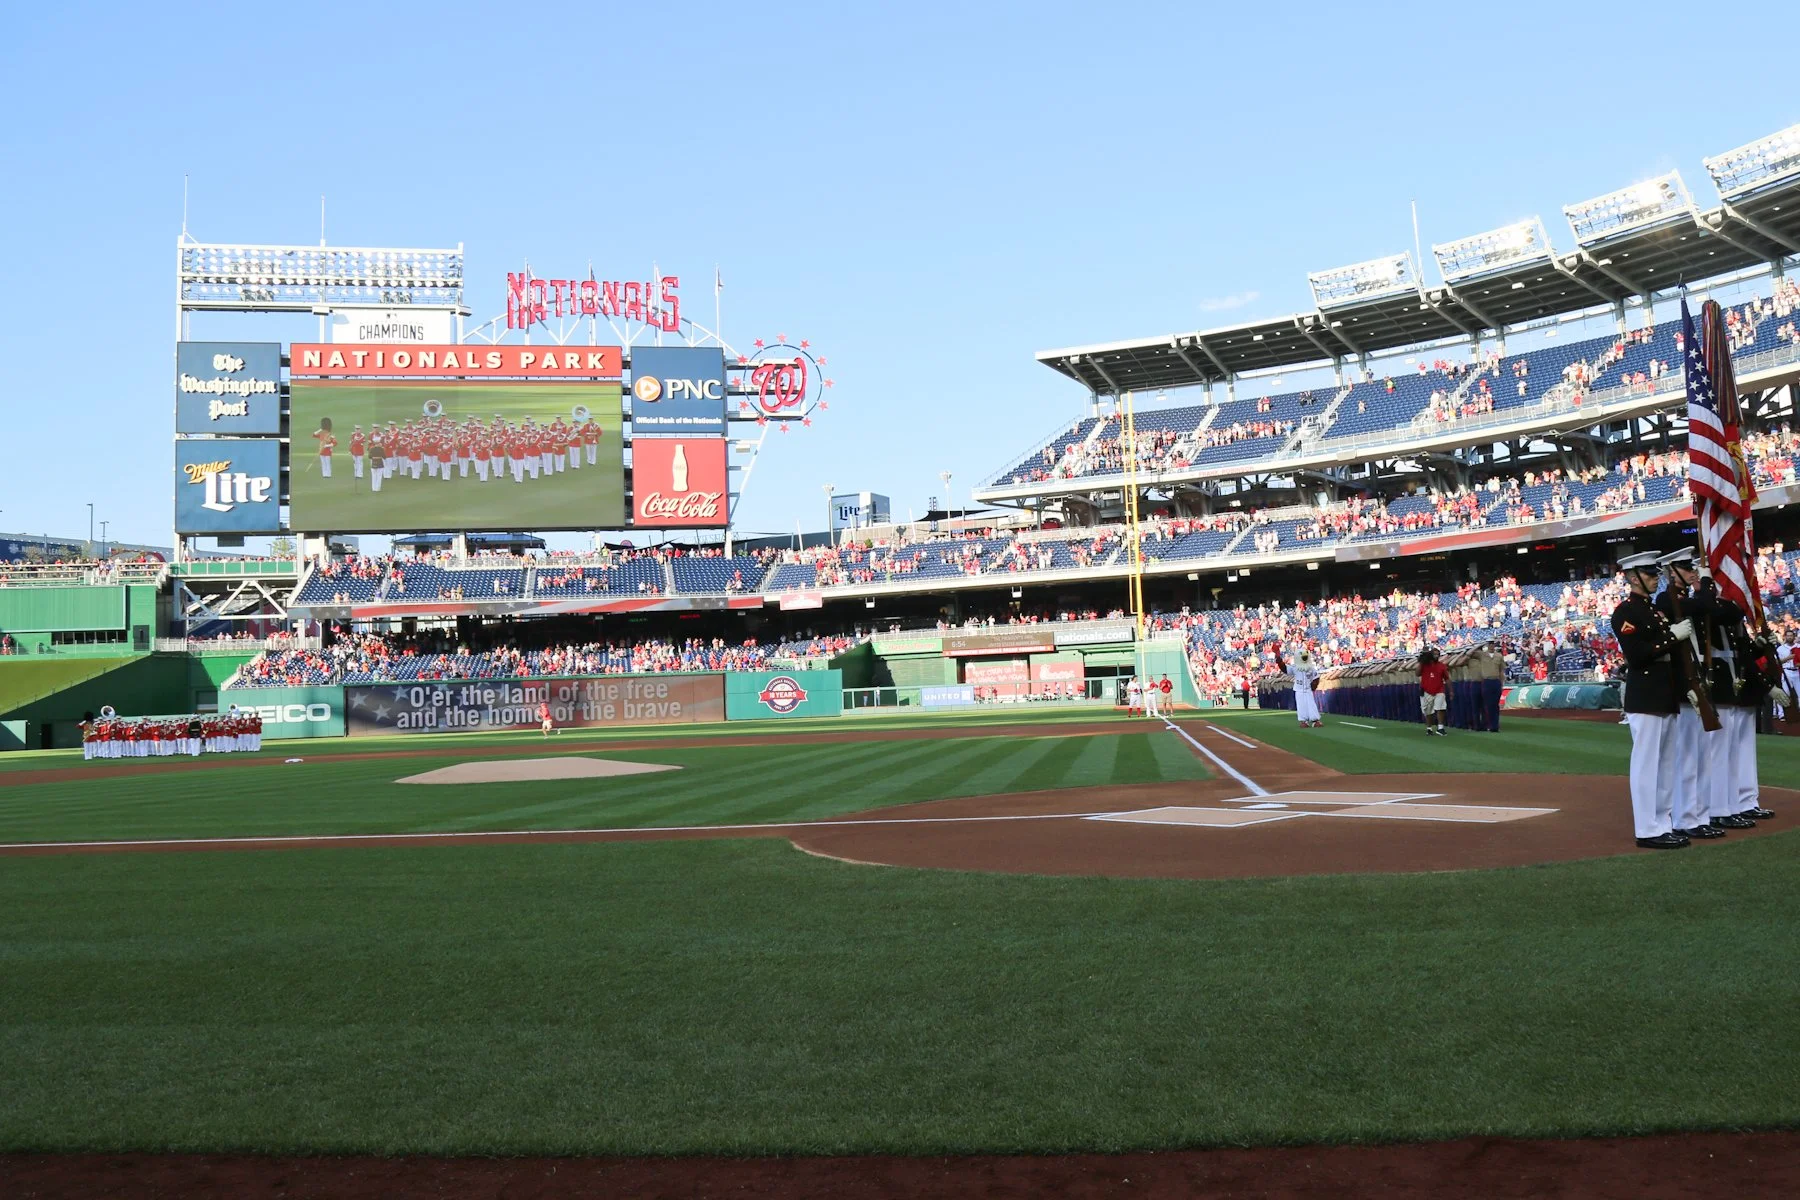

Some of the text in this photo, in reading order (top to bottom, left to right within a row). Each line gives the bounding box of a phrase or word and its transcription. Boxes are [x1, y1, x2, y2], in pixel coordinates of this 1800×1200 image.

[507, 272, 679, 332] NATIONALS
[359, 324, 424, 341] CHAMPIONS
[213, 353, 245, 373] The
[303, 350, 605, 370] NATIONALS PARK
[180, 373, 278, 397] Washington
[664, 378, 723, 400] PNC
[209, 399, 247, 421] Post
[636, 416, 722, 425] Official Bank of the Nationals
[183, 460, 231, 484] Miller
[201, 472, 272, 512] Lite
[640, 491, 724, 519] Coca-Cola
[839, 505, 860, 521] Lite
[1056, 631, 1130, 643] nationals.com
[410, 679, 668, 708] O'er the land of the free
[924, 692, 961, 701] UNITED
[397, 699, 682, 729] and the home of the brave
